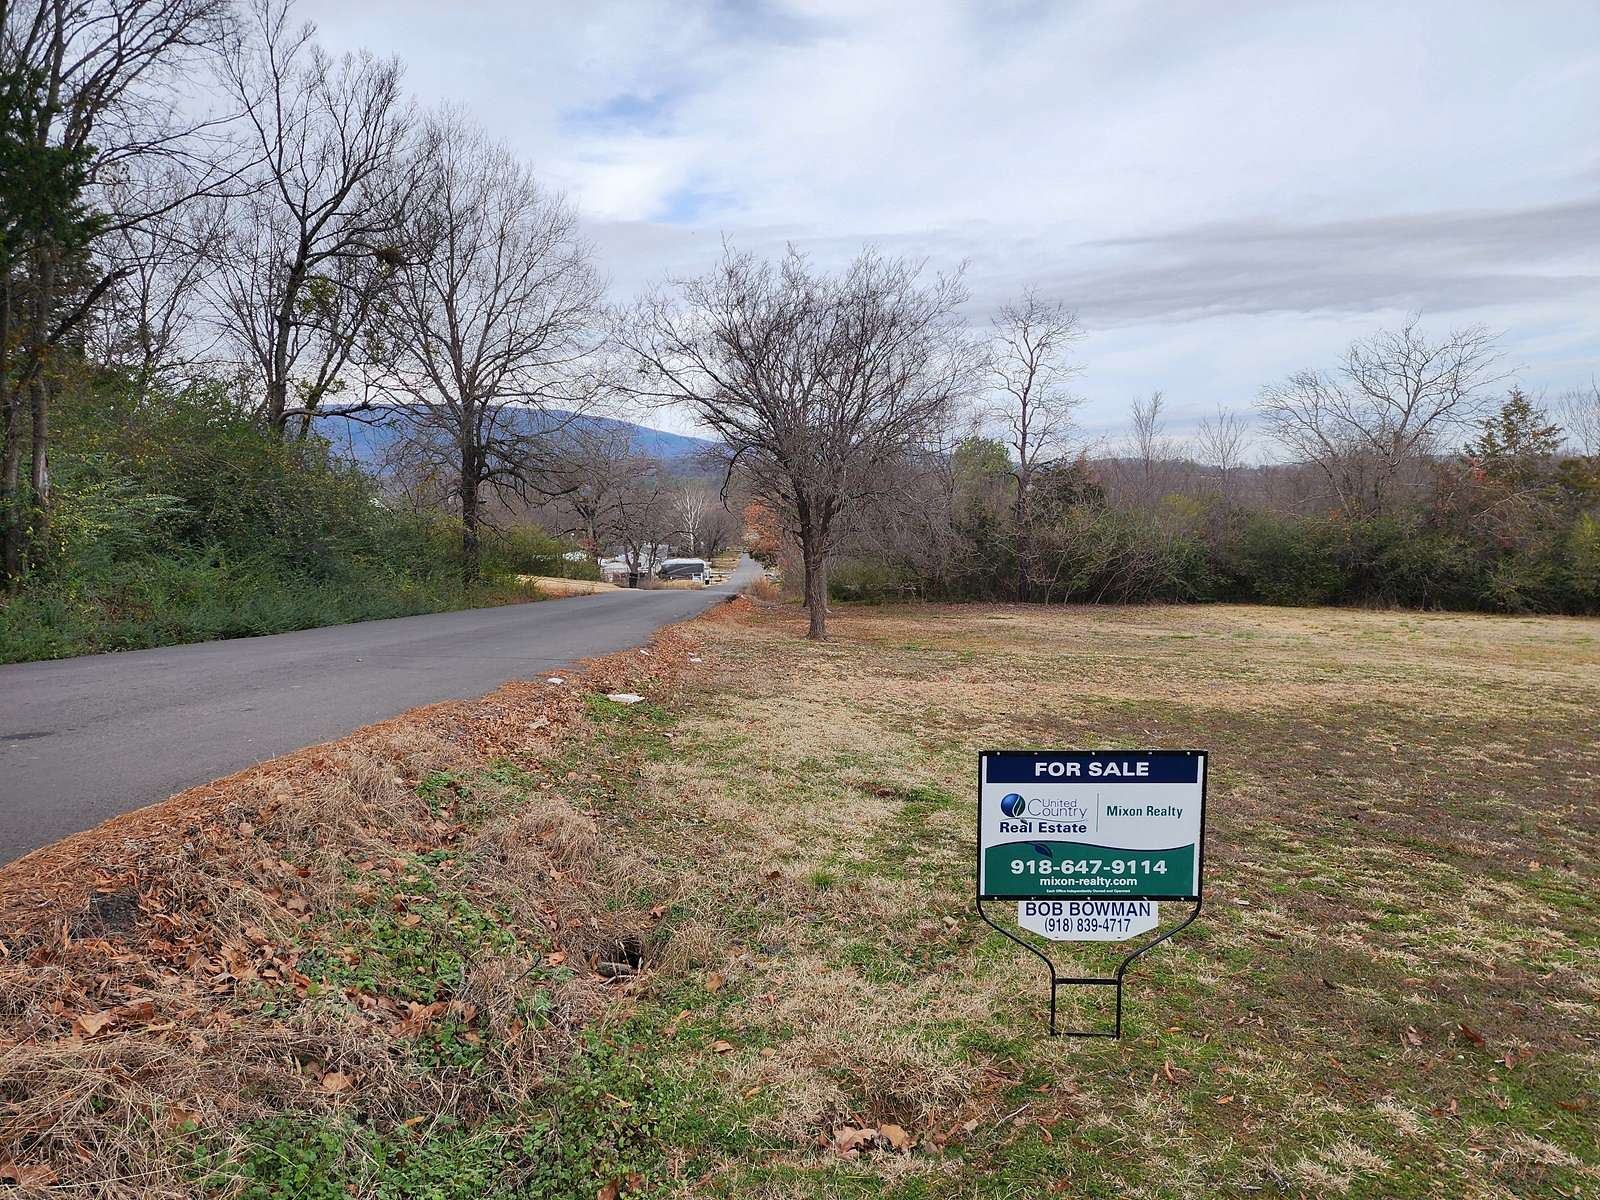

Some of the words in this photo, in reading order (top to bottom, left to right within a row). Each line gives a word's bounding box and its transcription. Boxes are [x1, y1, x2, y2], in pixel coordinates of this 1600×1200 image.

[1035, 762, 1080, 776] FOR
[1088, 762, 1149, 776] SALE
[1028, 798, 1087, 819] Country
[1042, 799, 1077, 808] United
[1106, 805, 1142, 816] Mixon
[1146, 805, 1183, 819] Realty
[1000, 822, 1032, 833] Real
[1038, 822, 1087, 833] Estate
[1010, 860, 1167, 875] 918-647-9114
[1039, 877, 1138, 888] mixon-realty.com
[1025, 902, 1063, 917] BOB
[1069, 902, 1151, 917] BOWMAN
[1044, 918, 1073, 933] (918)
[1077, 918, 1131, 933] 839-4717
